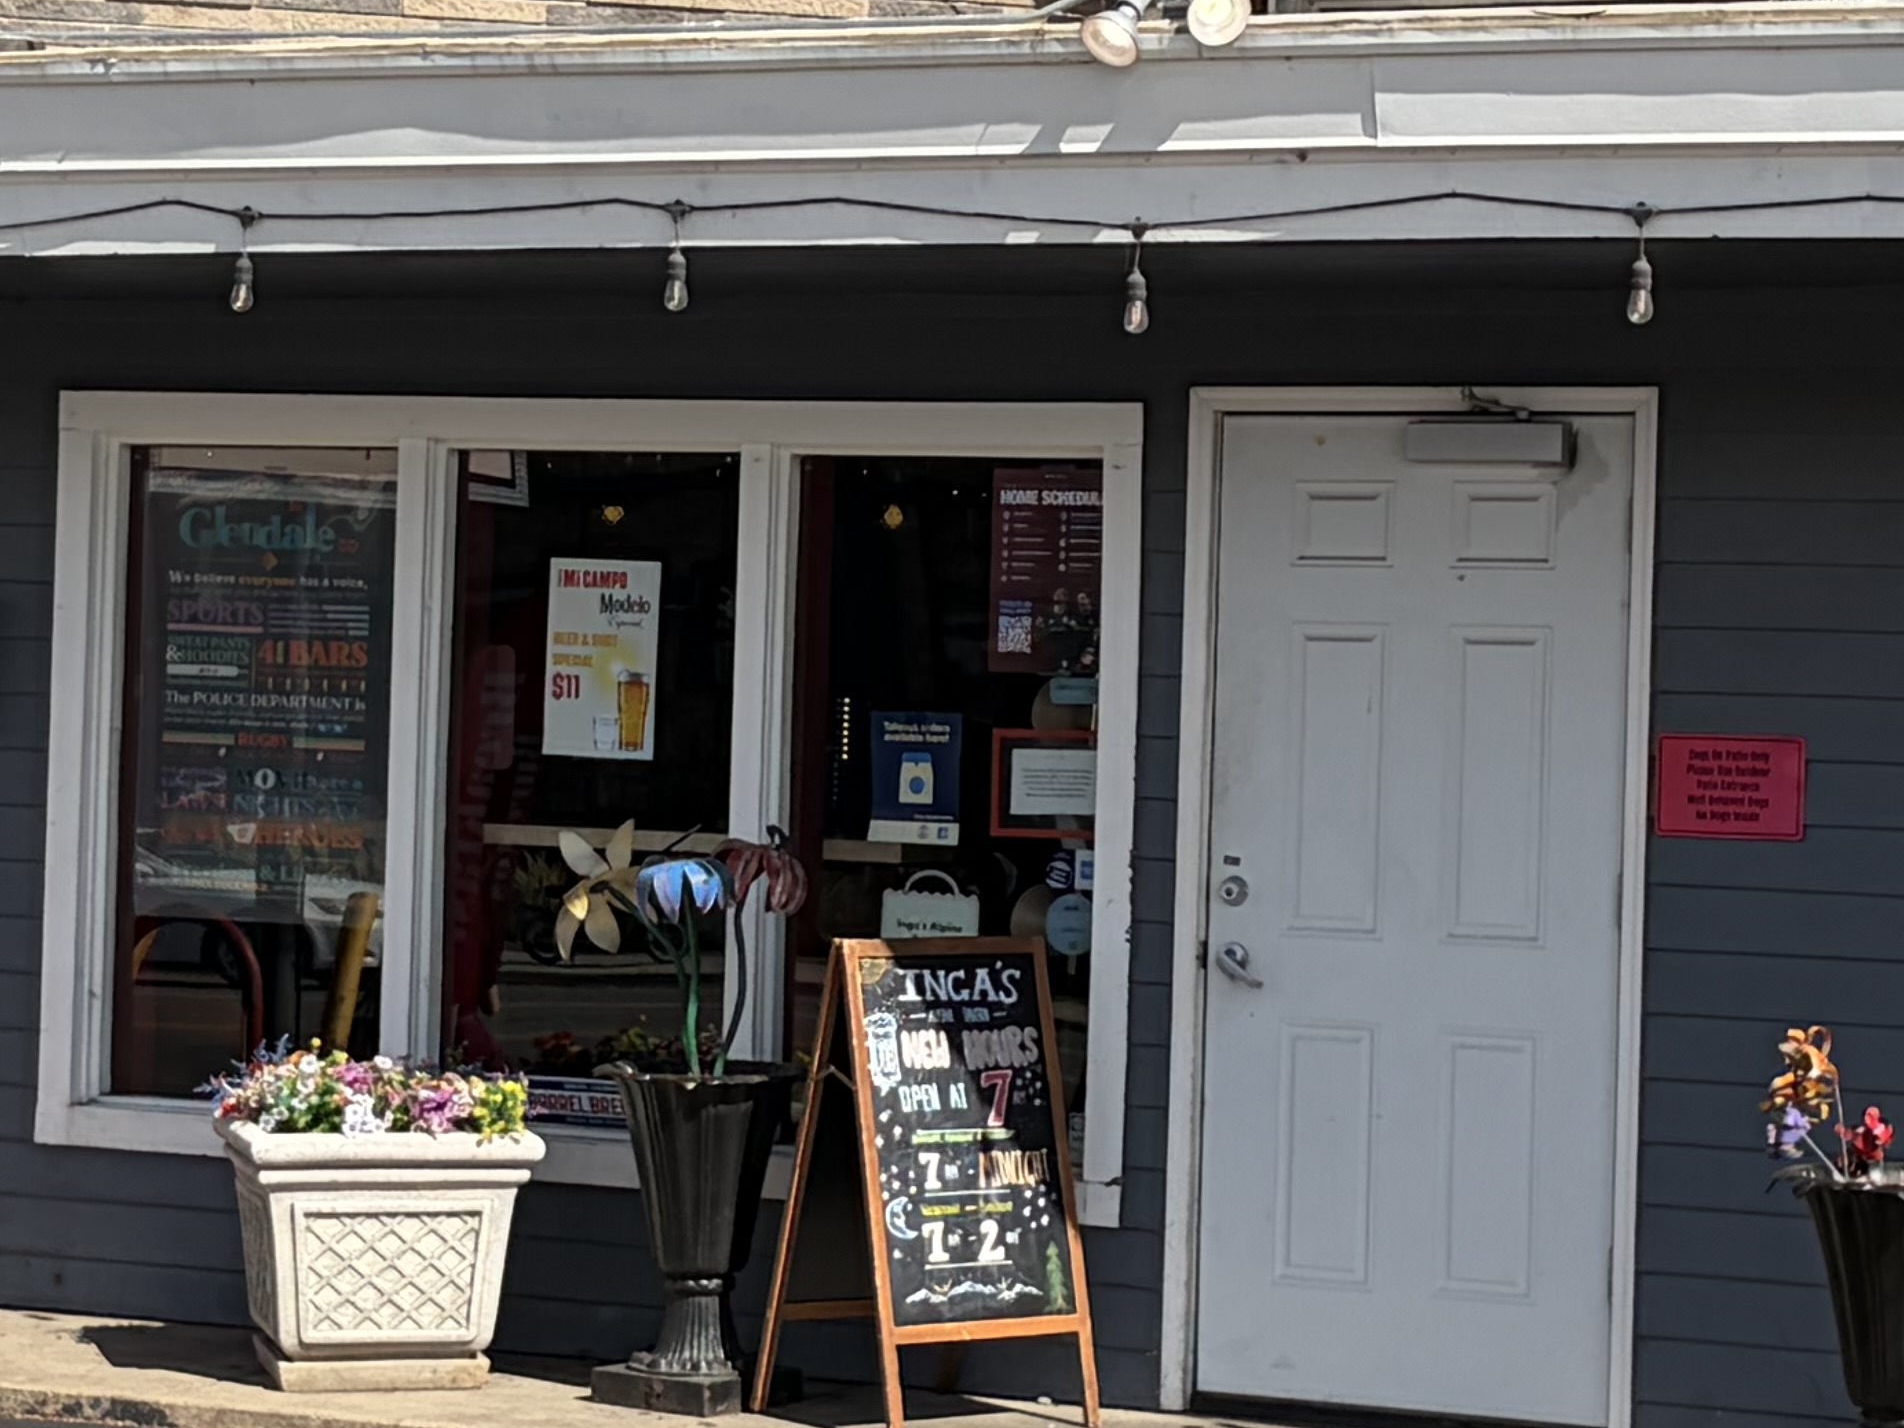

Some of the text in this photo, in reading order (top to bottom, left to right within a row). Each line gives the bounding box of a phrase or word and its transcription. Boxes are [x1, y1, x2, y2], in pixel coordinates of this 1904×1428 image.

[1000, 490, 1103, 507] HOME SCHEDUL
[179, 502, 336, 554] Glendale
[583, 570, 628, 590] CAMPO
[167, 600, 264, 625] SPORTS
[599, 592, 651, 615] Modelo
[288, 640, 369, 668] BARS
[164, 689, 190, 704] The
[193, 691, 250, 707] POLICE
[251, 693, 353, 713] DEPARTMENT
[552, 671, 581, 701] $11
[896, 960, 1021, 1004] INGA'S
[900, 1029, 952, 1070] NEW
[962, 1025, 1039, 1071] HOURS
[898, 1082, 942, 1113] OPEN
[948, 1082, 968, 1110] AT
[980, 1069, 1013, 1127] 7
[918, 1151, 943, 1190] 7
[978, 1148, 1051, 1189] MIDNIGHT
[921, 1221, 950, 1263] 7
[978, 1219, 1005, 1262] 2
